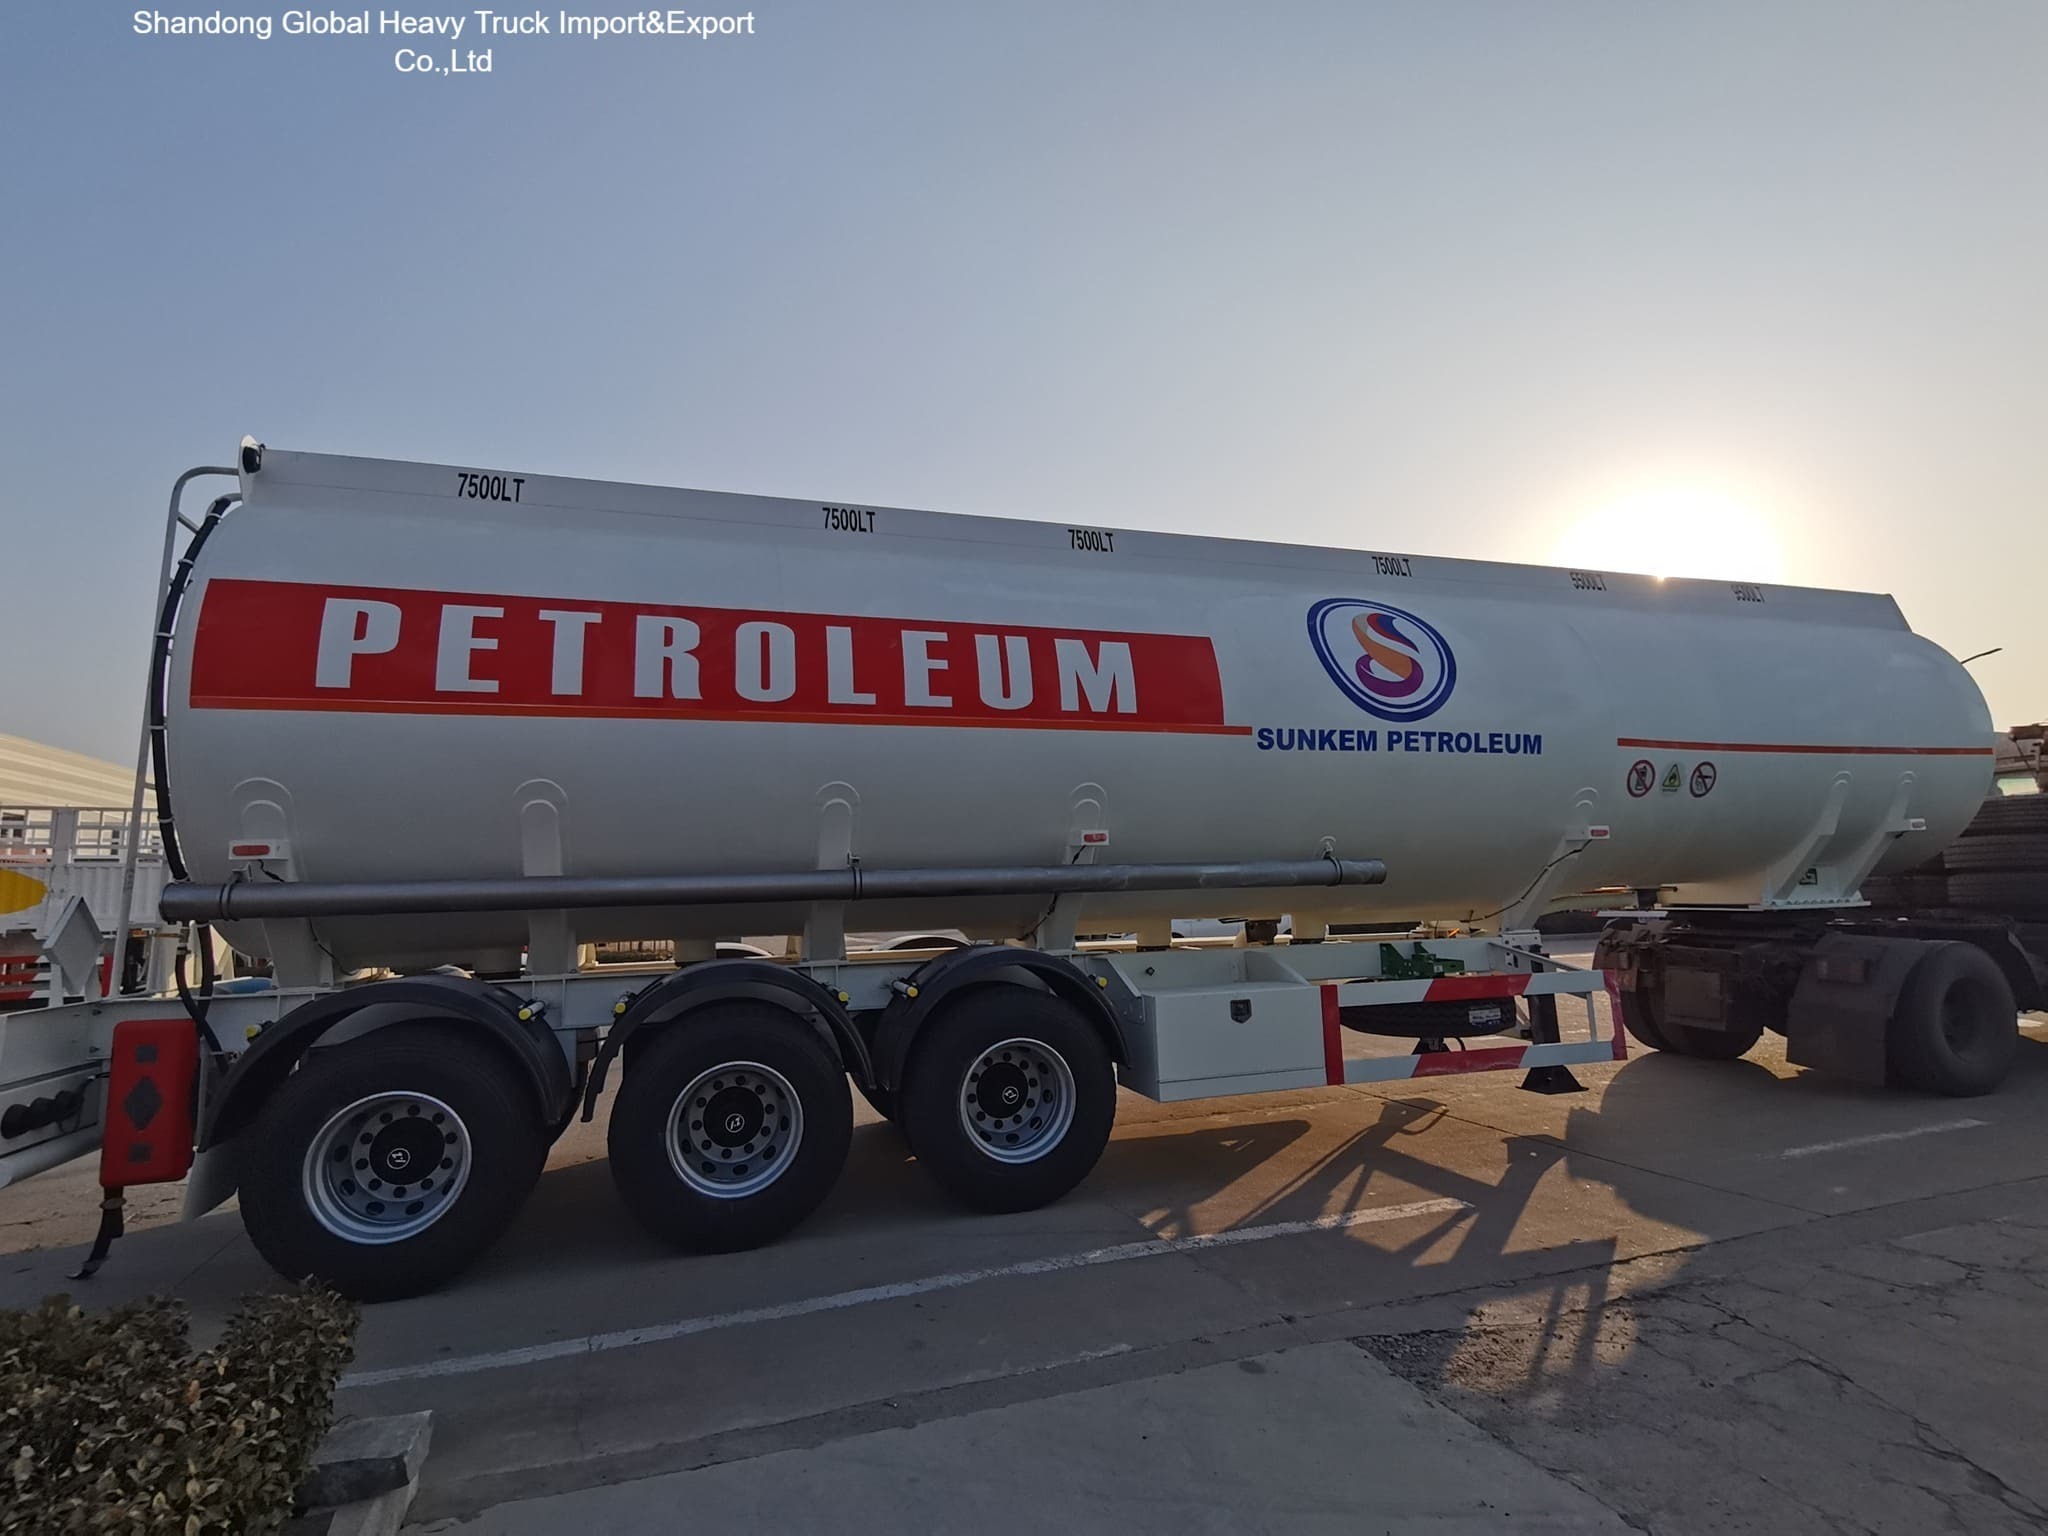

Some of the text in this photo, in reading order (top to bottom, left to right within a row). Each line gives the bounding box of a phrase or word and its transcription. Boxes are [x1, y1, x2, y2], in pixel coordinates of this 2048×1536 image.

[457, 472, 525, 503] 7500LT
[822, 507, 876, 533] 7500LT
[1067, 529, 1114, 552] 7500LT
[1371, 556, 1412, 577] 7500LT
[314, 597, 1139, 715] PETROLEUM
[1256, 727, 1543, 755] SUNKEM PETROLEUM
